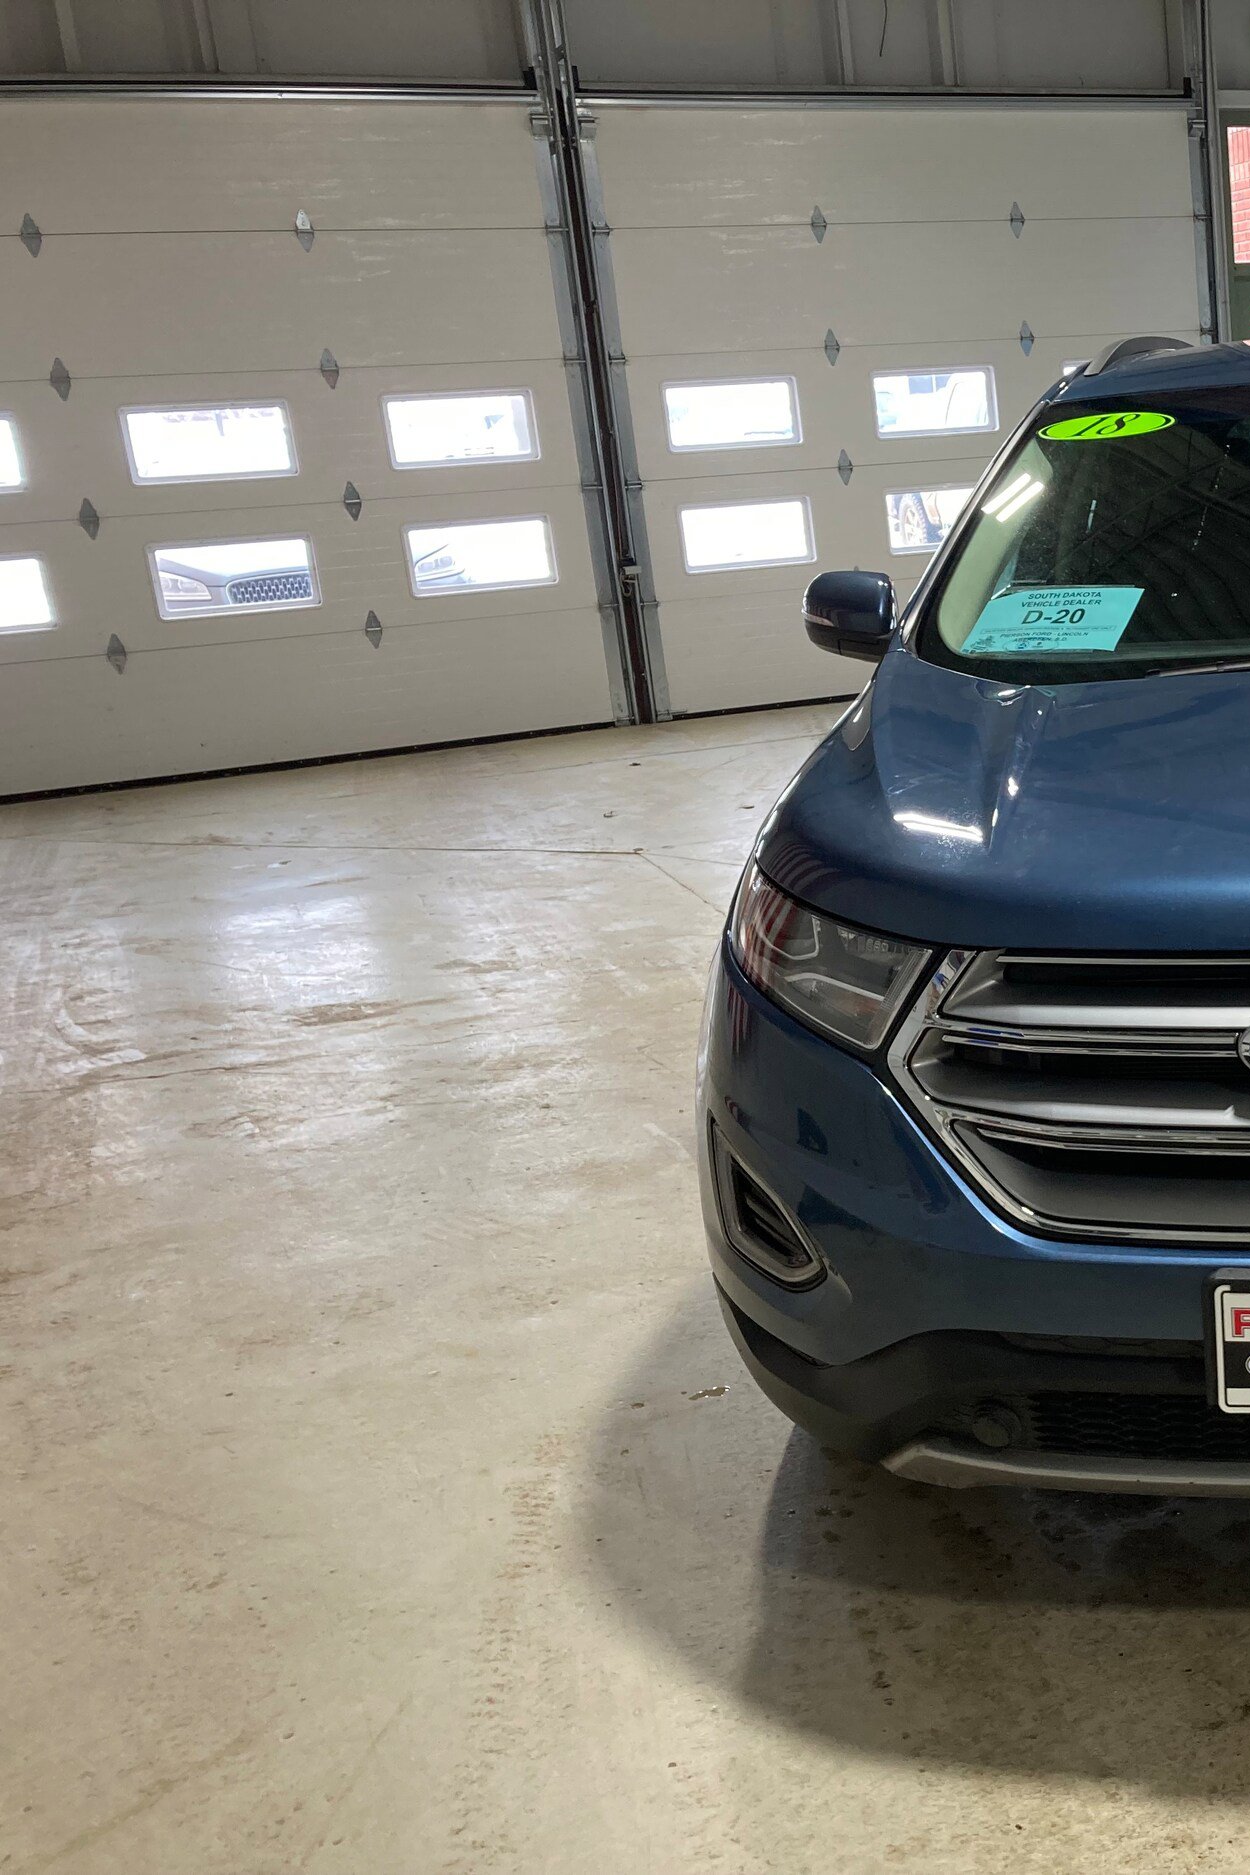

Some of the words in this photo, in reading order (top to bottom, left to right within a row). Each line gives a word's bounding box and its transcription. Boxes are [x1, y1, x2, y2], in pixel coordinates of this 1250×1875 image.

[1066, 413, 1141, 437] 18
[1028, 592, 1060, 600] SOUTH
[1062, 591, 1102, 599] DAKOTA
[1021, 600, 1061, 608] VEHICLE
[1021, 608, 1086, 625] D-20
